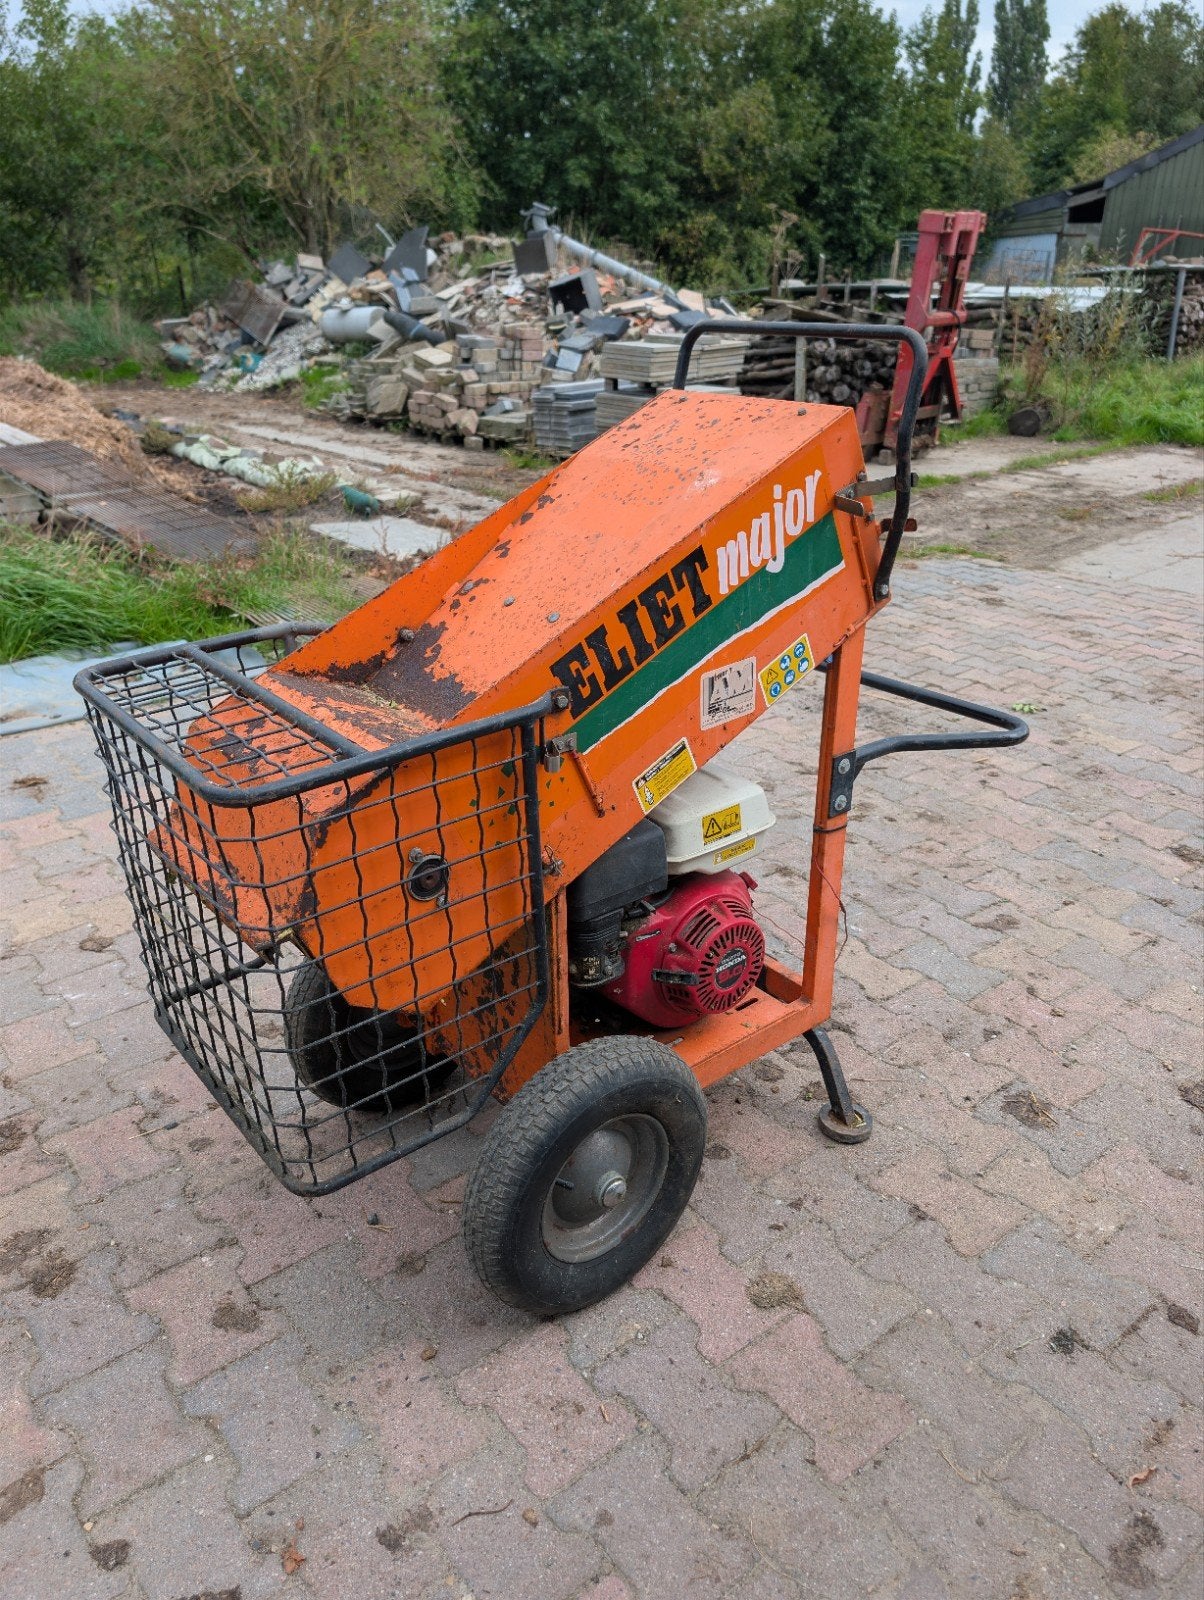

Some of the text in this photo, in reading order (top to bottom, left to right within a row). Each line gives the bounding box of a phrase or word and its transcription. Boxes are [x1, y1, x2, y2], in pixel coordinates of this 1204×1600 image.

[550, 470, 822, 719] ELIET major
[716, 955, 746, 973] HONDA
